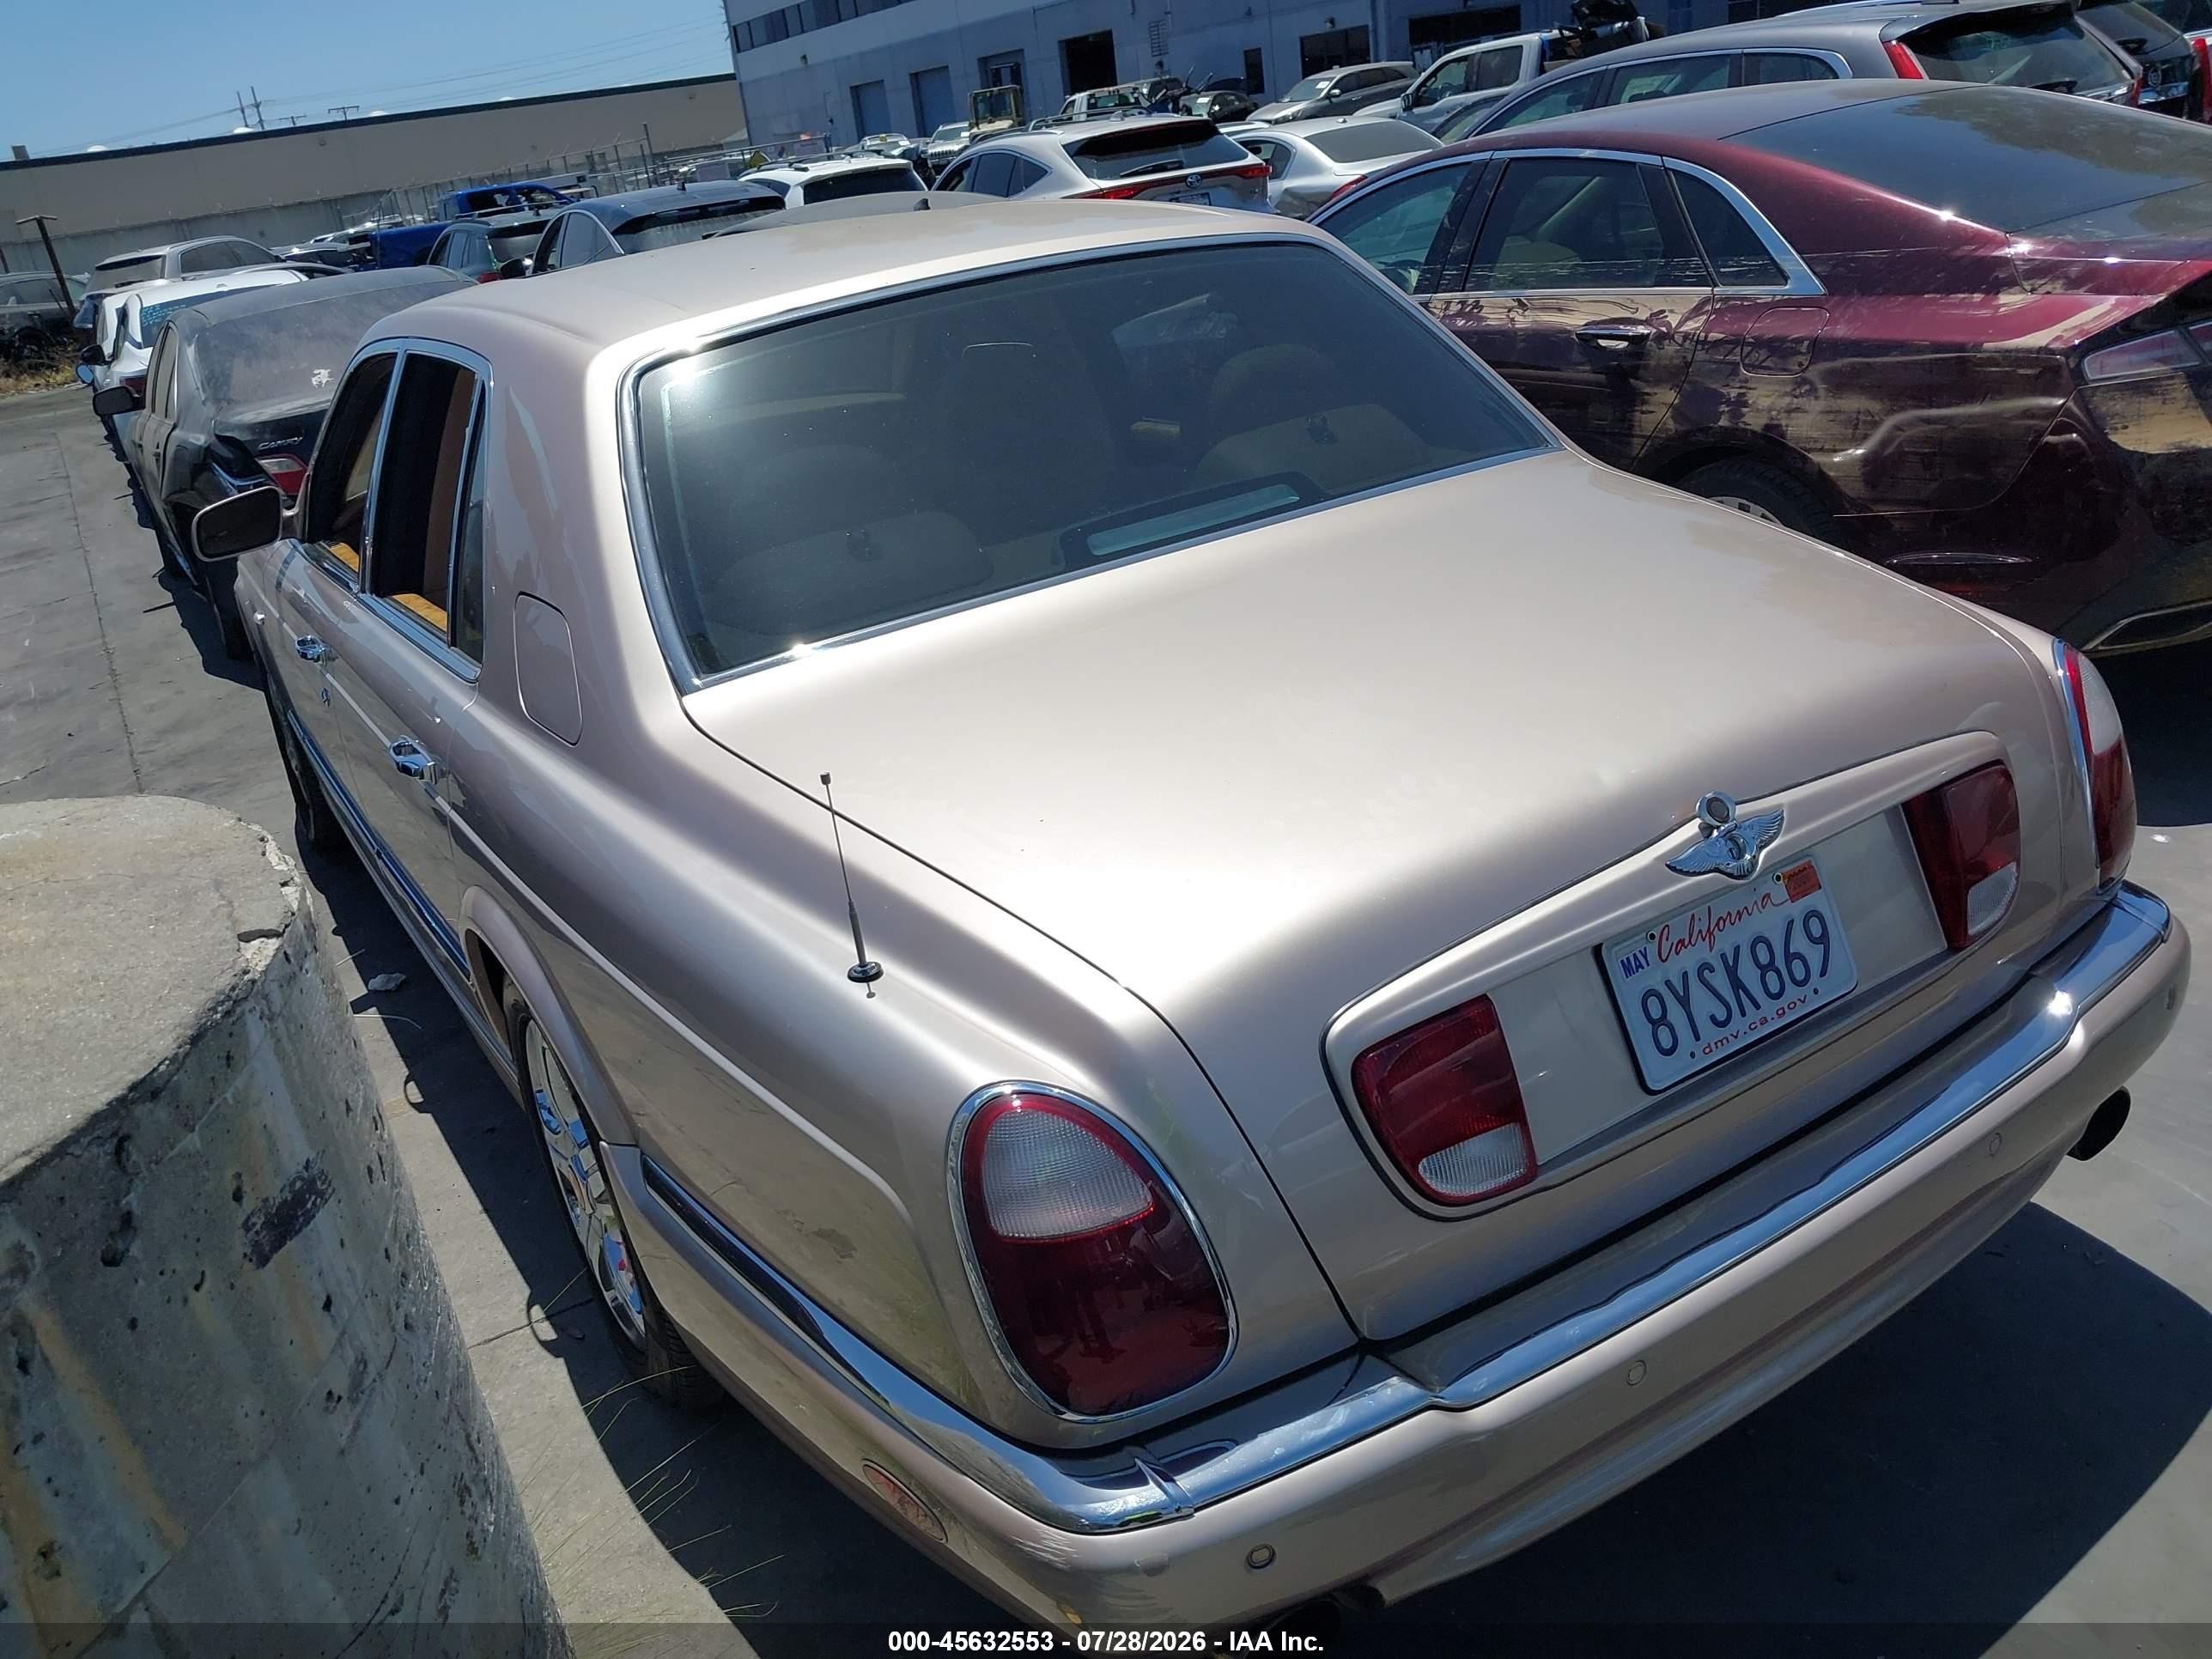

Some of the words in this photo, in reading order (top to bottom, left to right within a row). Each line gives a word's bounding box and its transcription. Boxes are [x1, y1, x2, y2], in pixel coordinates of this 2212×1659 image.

[1657, 887, 1789, 963] California
[1620, 946, 1650, 979] MAY
[1641, 909, 1830, 1056] 8YSK869
[1703, 994, 1808, 1055] dmv.ca.gov
